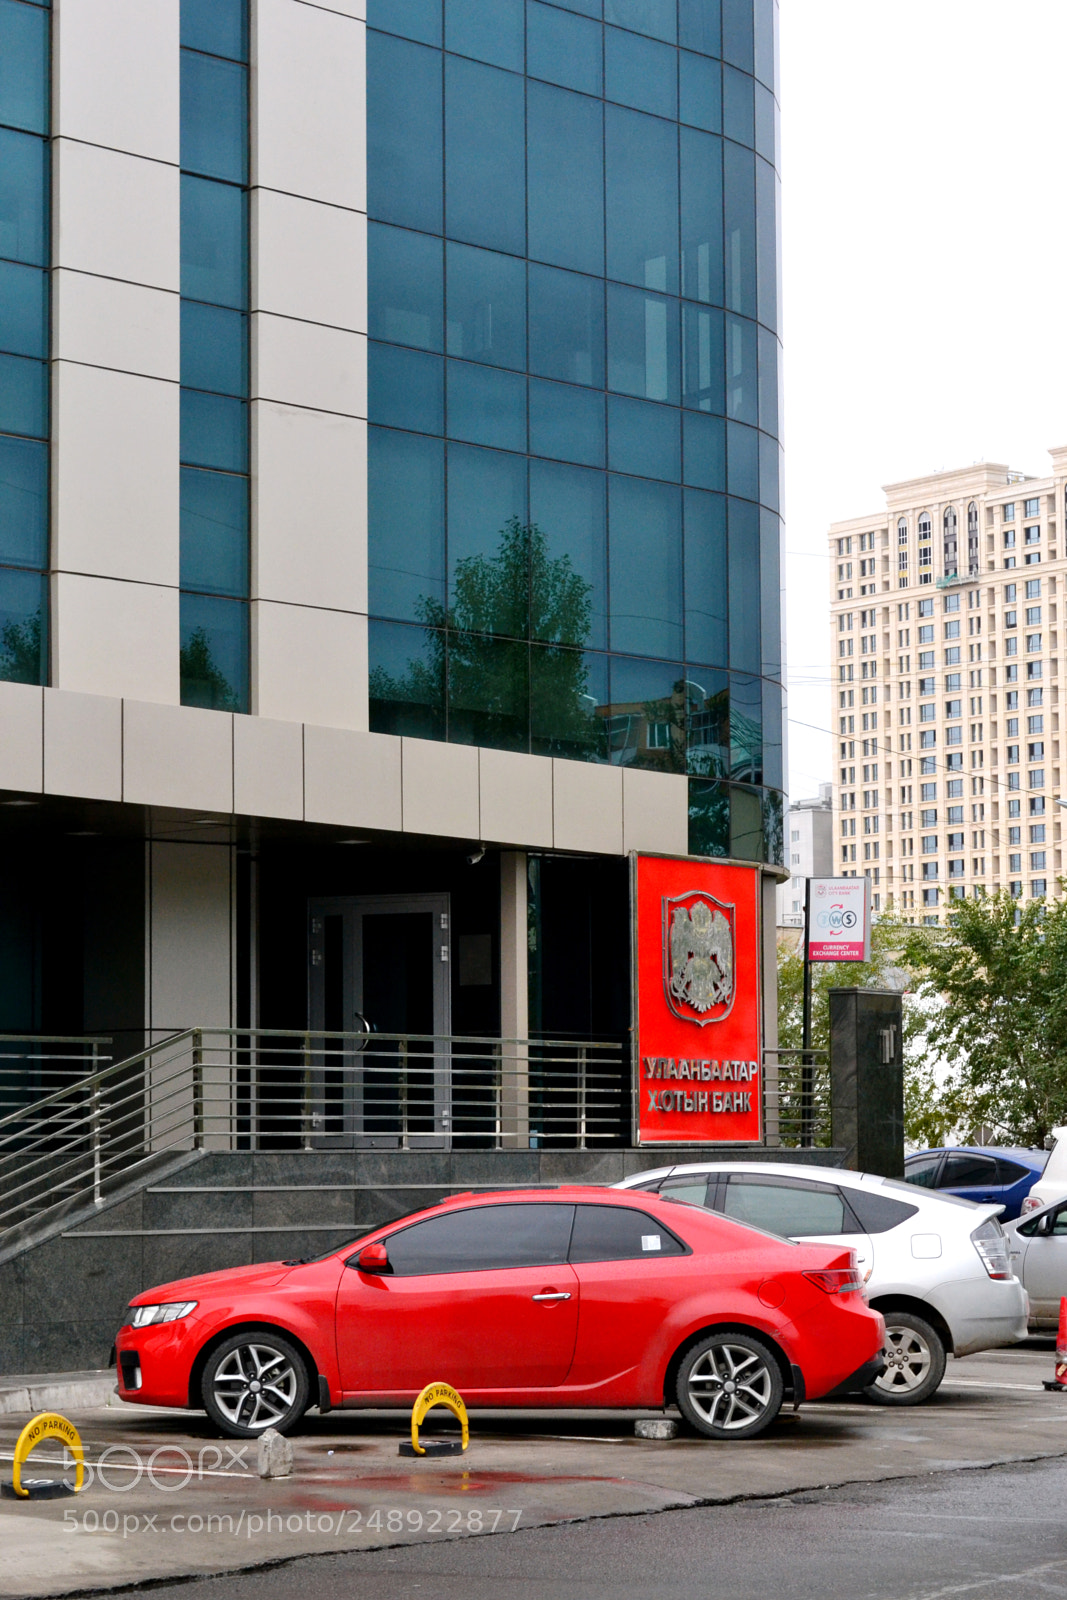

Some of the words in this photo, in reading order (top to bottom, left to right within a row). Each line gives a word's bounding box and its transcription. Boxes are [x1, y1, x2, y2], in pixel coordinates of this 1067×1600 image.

[643, 1057, 758, 1082] УЛААНБААТАР
[648, 1090, 708, 1112] ХОТЫН
[712, 1091, 752, 1113] БАНК
[424, 1392, 434, 1405] NO
[436, 1389, 462, 1408] PARKING
[28, 1426, 40, 1441] NO
[43, 1420, 76, 1440] PARKING
